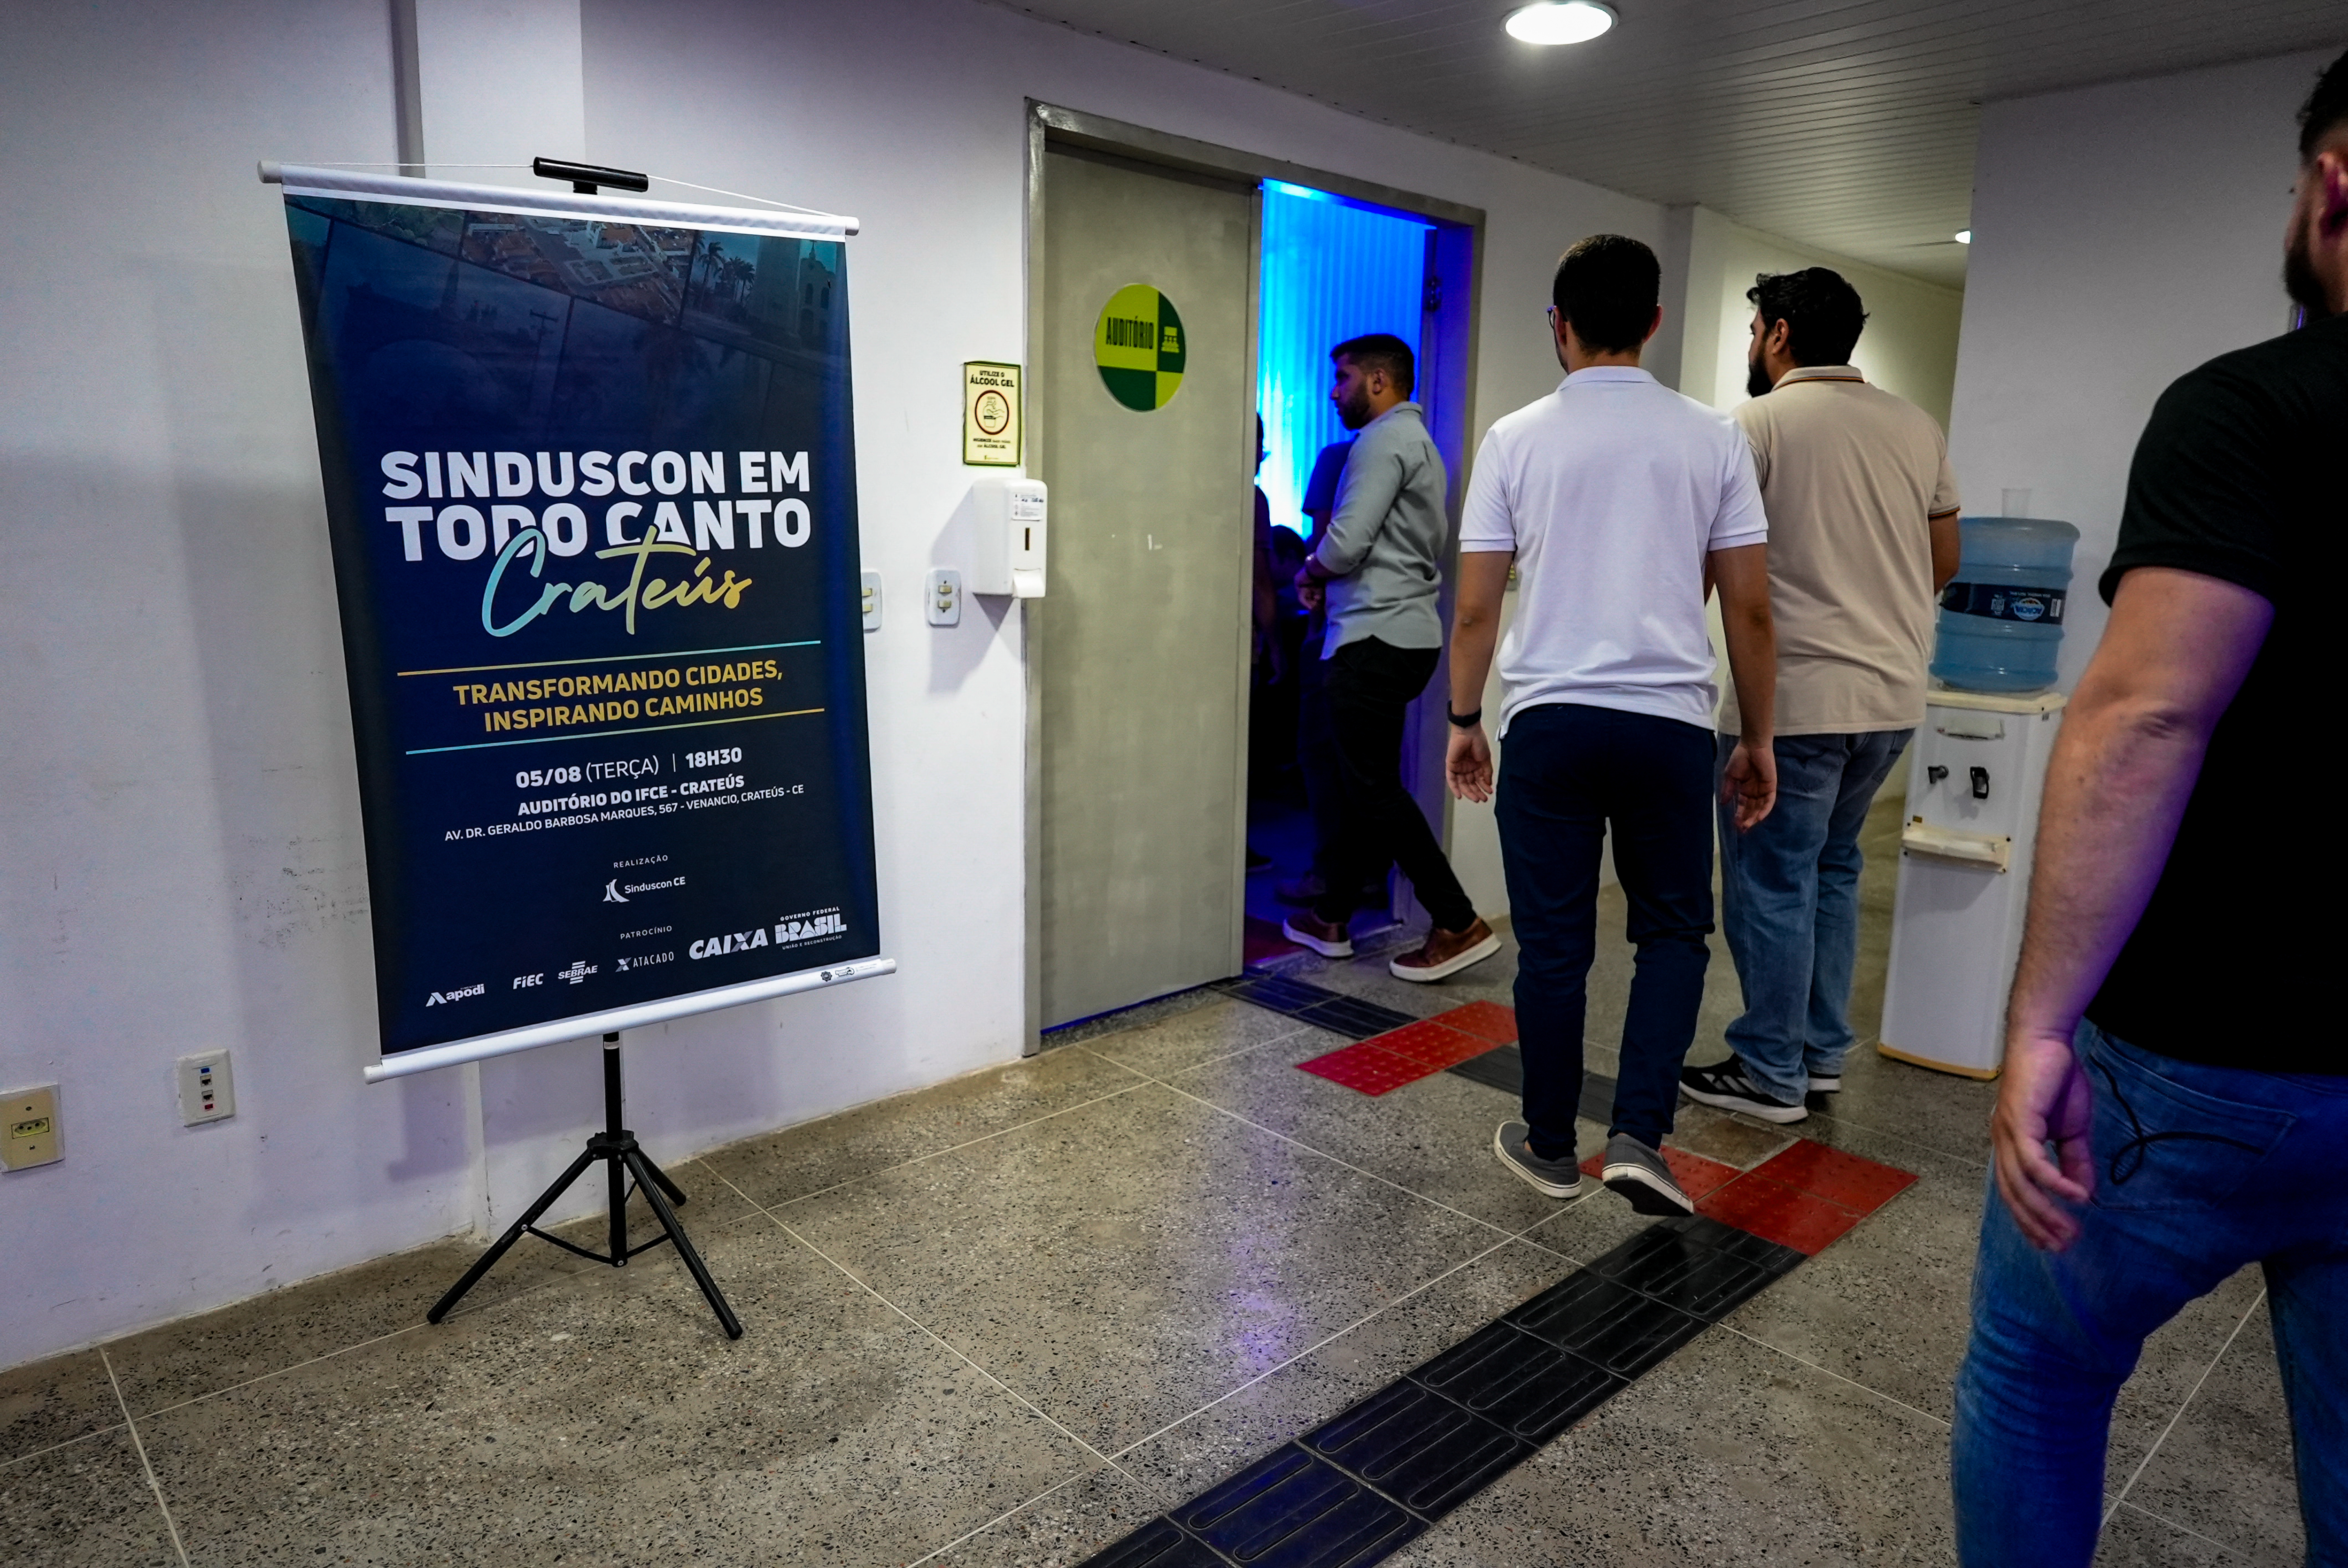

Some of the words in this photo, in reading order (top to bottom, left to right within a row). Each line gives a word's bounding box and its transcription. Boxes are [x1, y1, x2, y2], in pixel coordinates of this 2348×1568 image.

[1106, 315, 1154, 349] AUDITÓRIO
[970, 374, 999, 385] ÁLCOOL
[1001, 379, 1014, 387] GEL
[381, 450, 726, 500] SINDUSCON
[739, 451, 810, 493] EM
[385, 502, 588, 561] TODO
[605, 498, 811, 550] CANTO
[482, 525, 752, 637] Crateús
[453, 669, 680, 705] TRANSFORMANDO
[686, 660, 782, 686] CIDADES,
[485, 700, 639, 732] INSPIRANDO
[645, 688, 763, 716] CAMINHOS
[516, 766, 581, 788] 05/08
[586, 755, 659, 783] (TERÇA)
[685, 747, 742, 769] 18H30
[517, 792, 607, 816] AUDITÓRIO
[610, 790, 632, 805] DO
[635, 785, 668, 801] IFCE
[680, 774, 745, 795] CRATEÚS
[445, 830, 463, 841] AV.
[465, 828, 486, 838] DR.
[487, 820, 542, 836] GERALDO
[544, 813, 599, 829] BARBOSA
[600, 806, 657, 822] MARQUES,
[658, 803, 678, 814] 567
[686, 794, 740, 810] VENANCIO,
[741, 786, 785, 802] CRATEÚS
[792, 784, 804, 794] CE
[613, 855, 668, 869] REALIZAÇÃO
[624, 880, 672, 894] Sinduscon
[775, 913, 847, 944] BRASIL
[780, 911, 811, 922] GOVERNO
[812, 906, 840, 915] FEDERAL
[620, 925, 672, 939] PATROCÍNIO
[689, 928, 768, 960] CAIXA
[804, 934, 842, 945] RECONSTRUÇÃO
[558, 965, 598, 979] SEBRAE
[633, 951, 674, 968] ATACADO
[446, 984, 485, 1001] apodi
